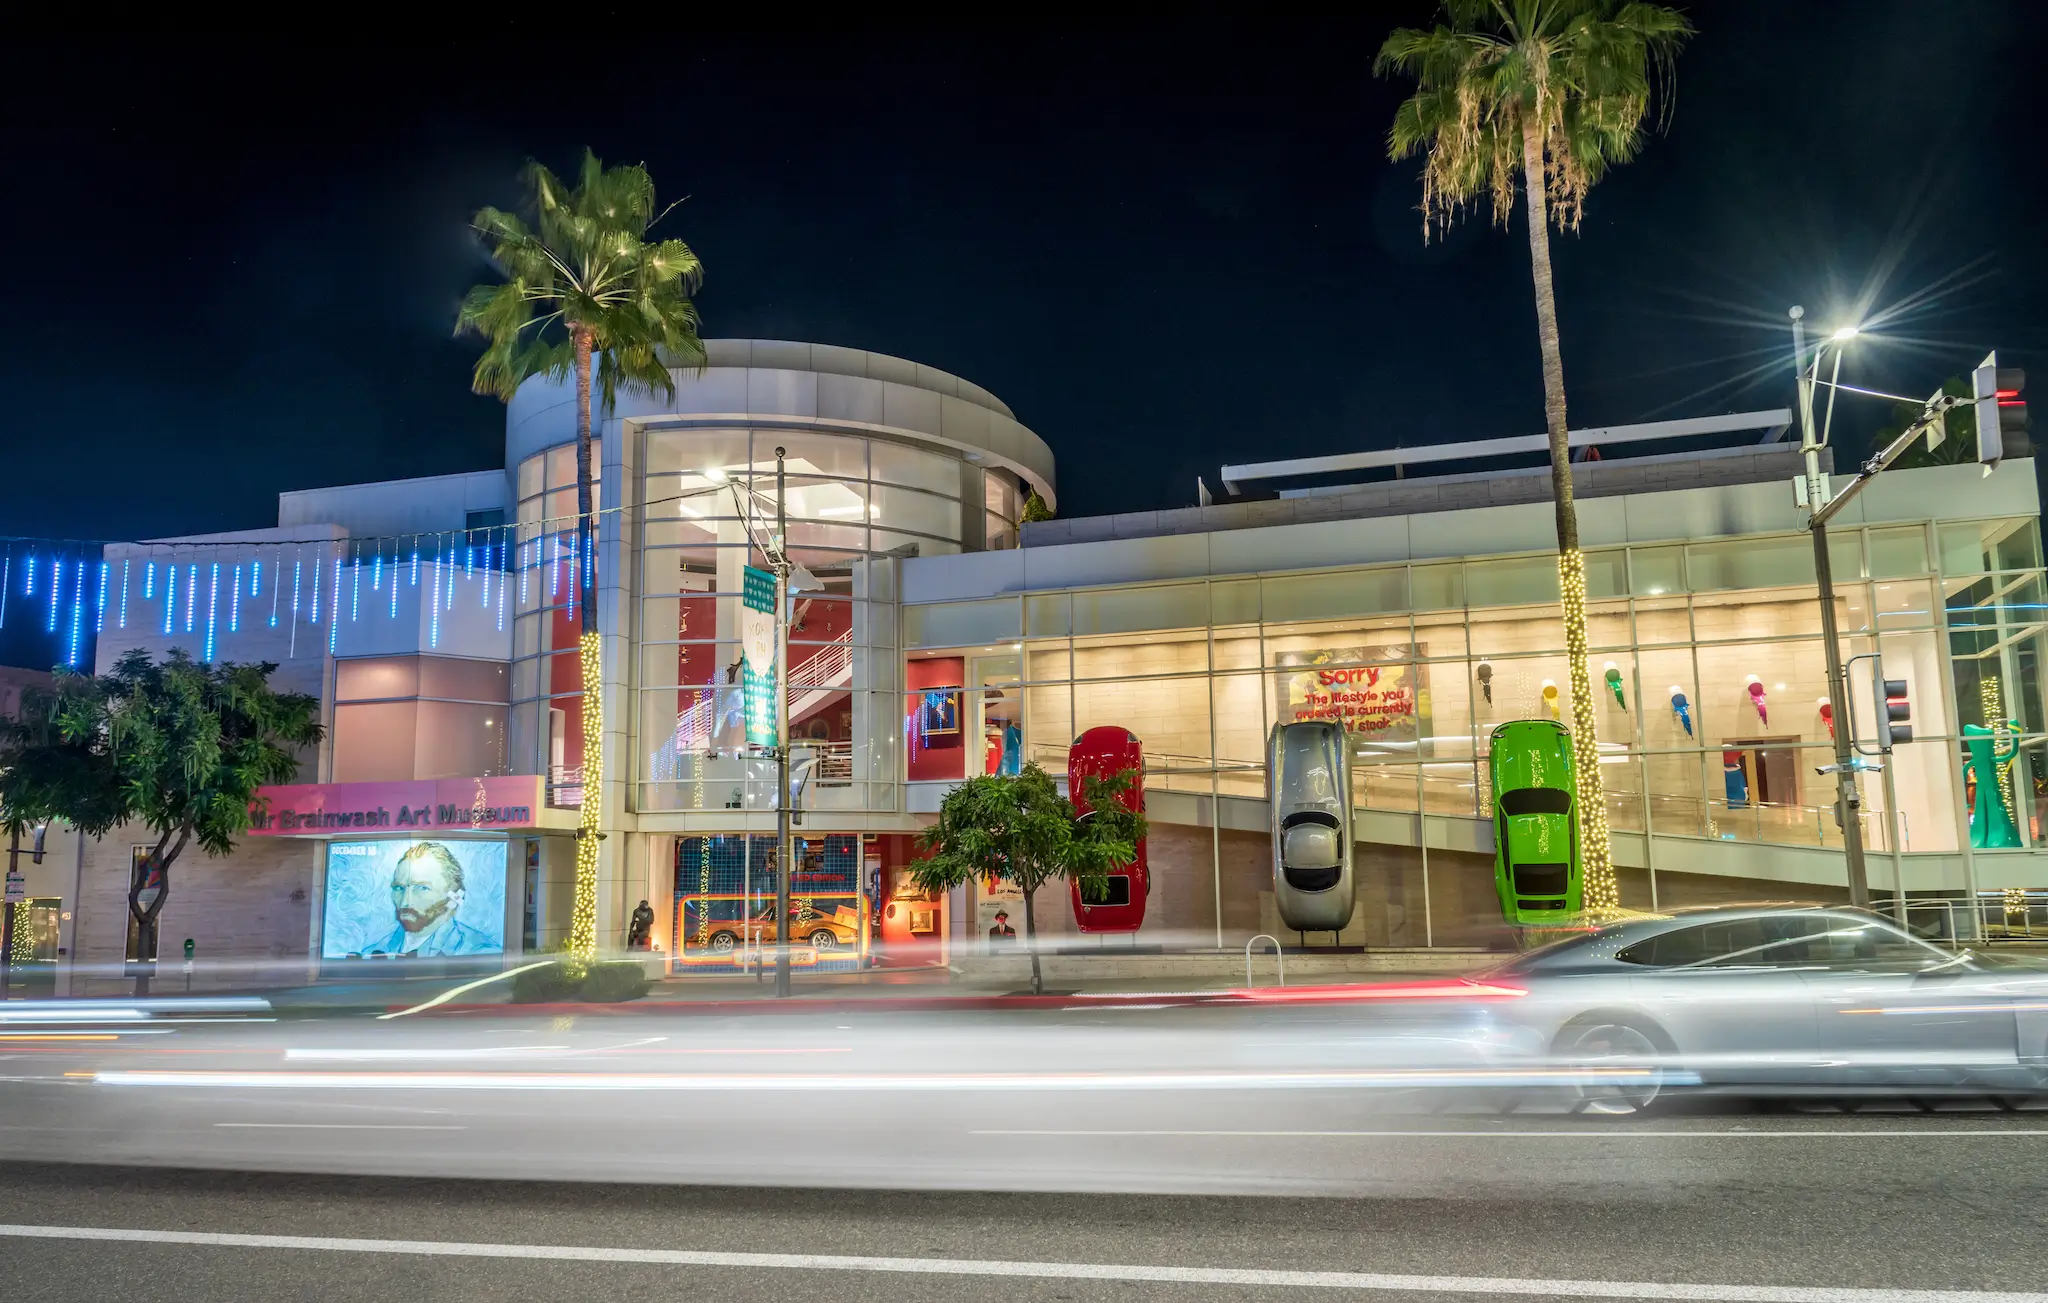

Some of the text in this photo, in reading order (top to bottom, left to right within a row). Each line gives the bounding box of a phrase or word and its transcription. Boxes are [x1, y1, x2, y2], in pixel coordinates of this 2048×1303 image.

[1319, 667, 1379, 686] Sorry
[1305, 690, 1404, 704] The lifestyle you
[1295, 702, 1413, 719] ordered is currently
[250, 803, 530, 829] Mr Brainwash Art Museum
[332, 846, 366, 856] DECEMBER
